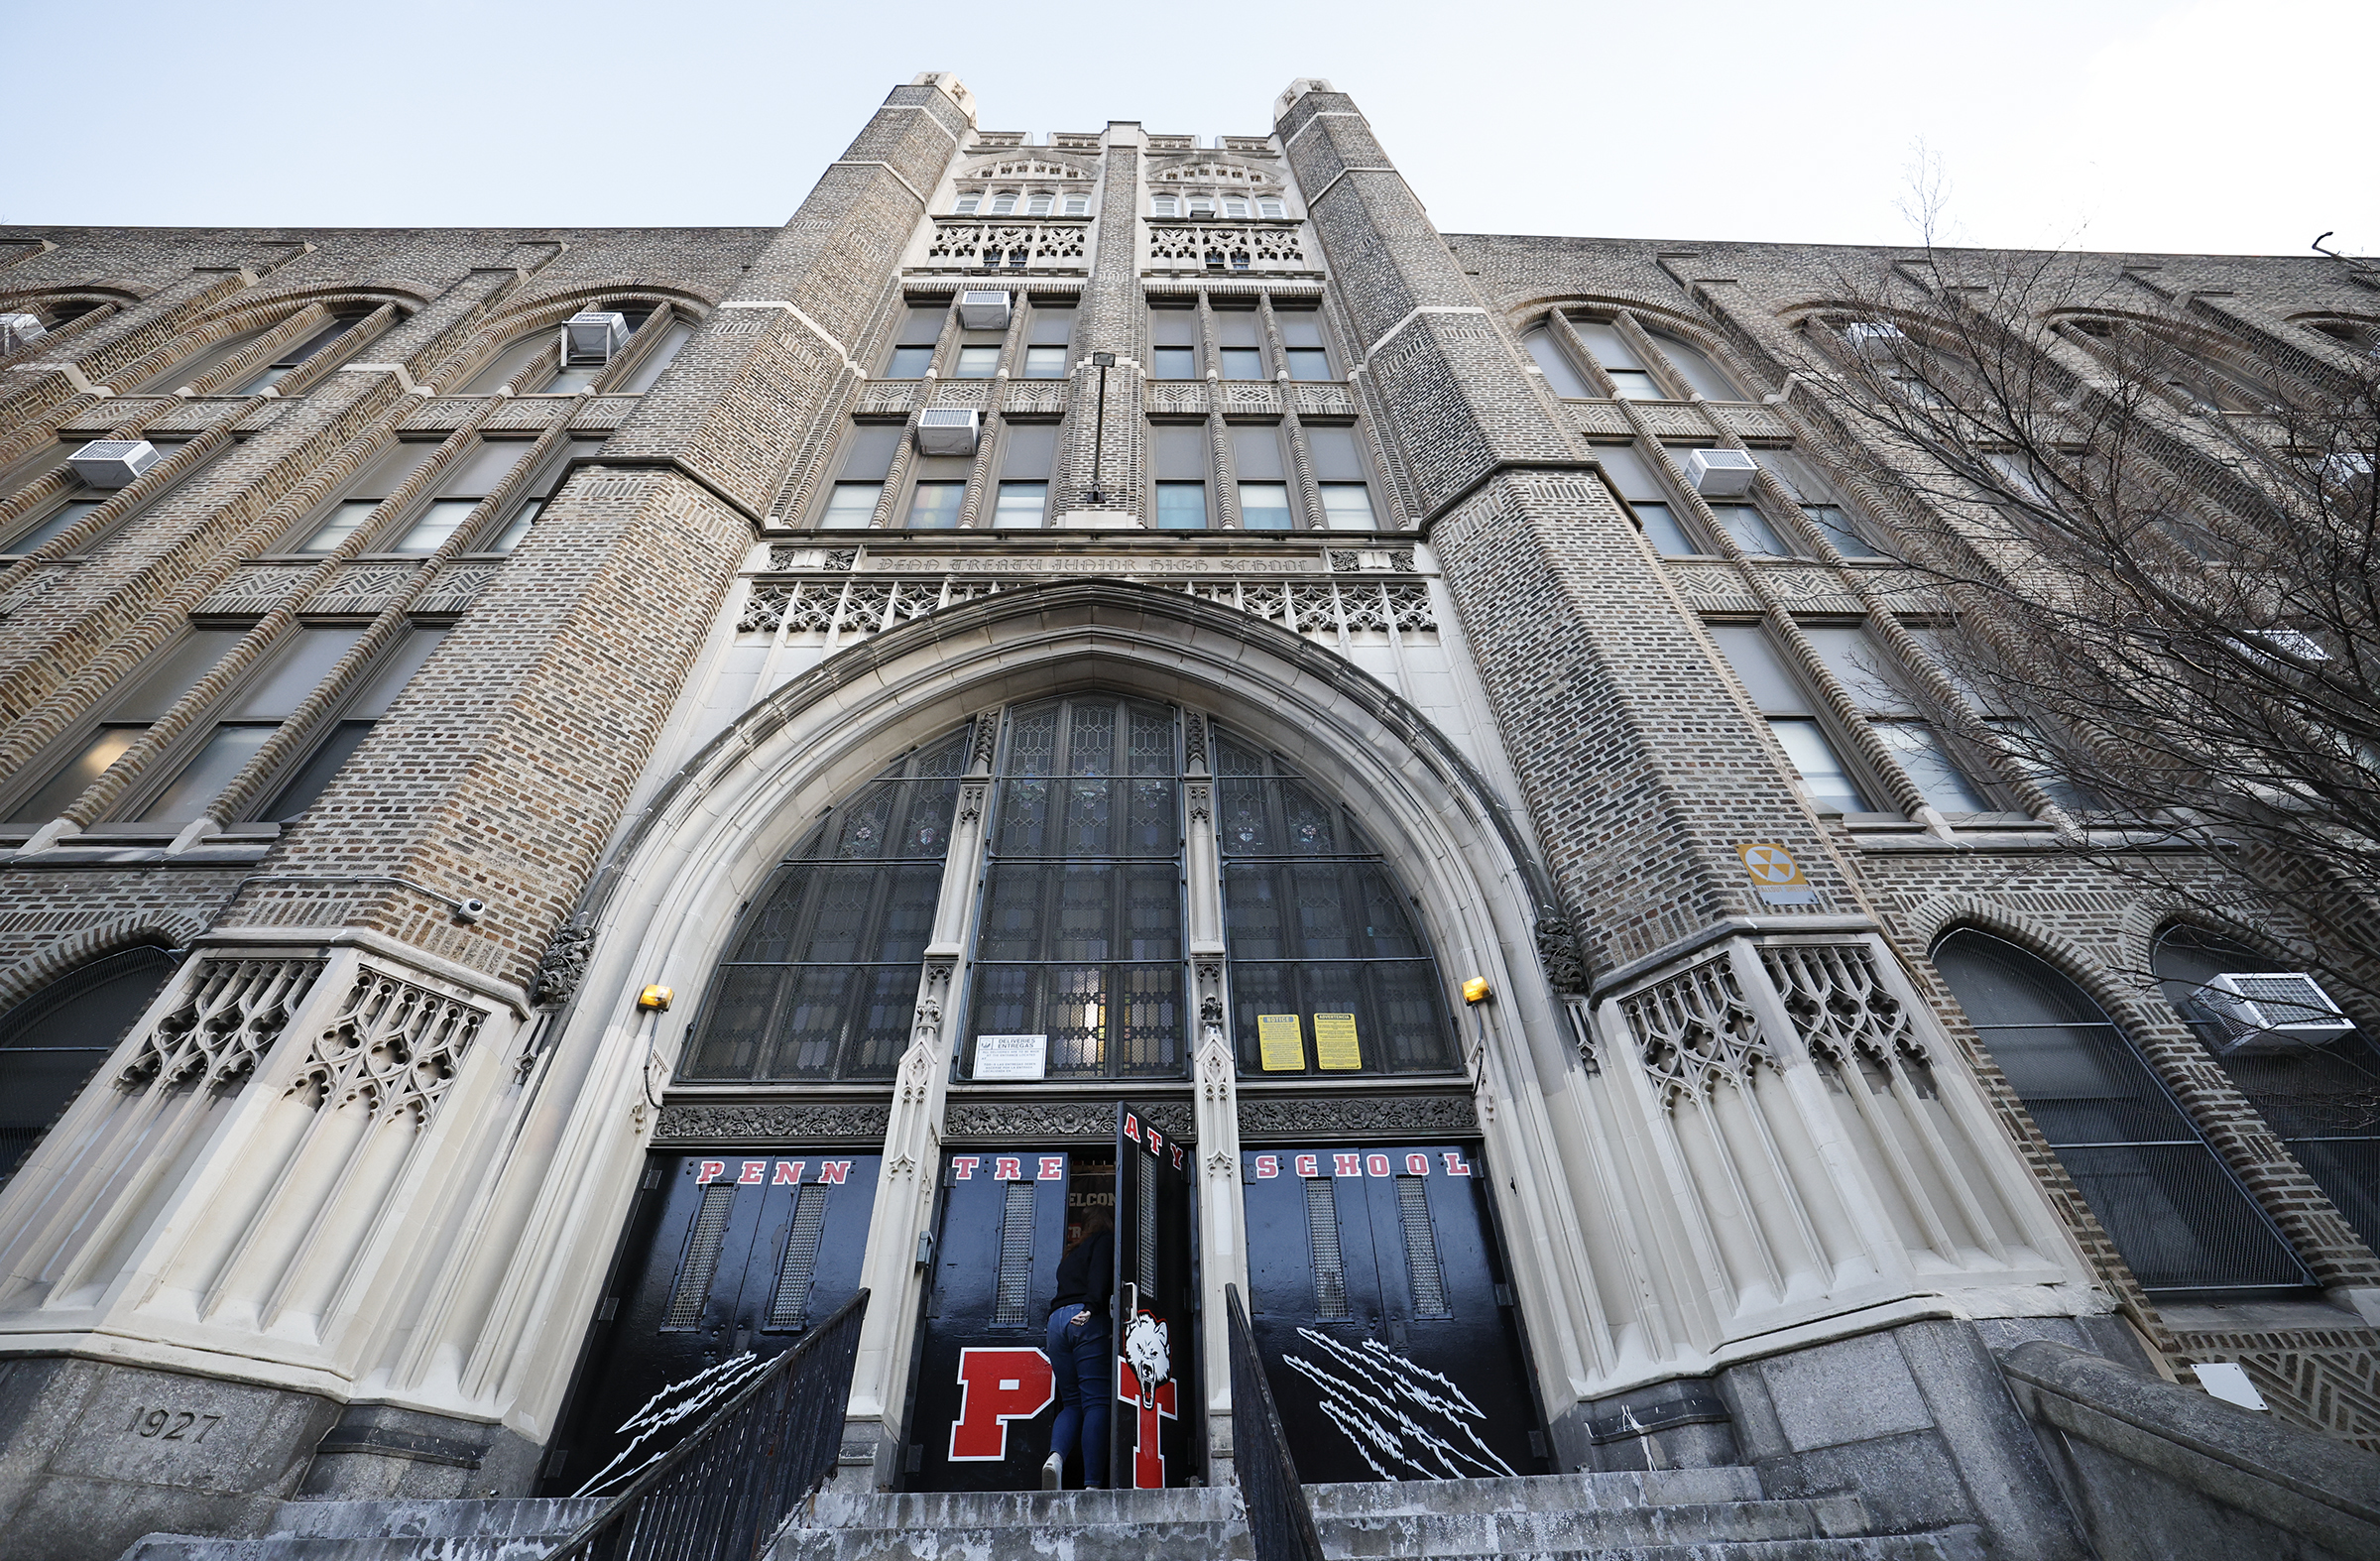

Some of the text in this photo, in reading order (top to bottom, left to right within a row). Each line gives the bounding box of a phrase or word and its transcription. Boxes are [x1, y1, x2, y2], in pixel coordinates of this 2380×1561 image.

[949, 558, 1042, 571] TREATY
[1051, 558, 1137, 571] JUNIOR
[1148, 558, 1209, 571] HIGH
[1220, 559, 1312, 572] SCHOOL
[695, 1160, 850, 1185] PENN
[1254, 1152, 1472, 1179] SCHOOL
[124, 1405, 221, 1444] 1927
